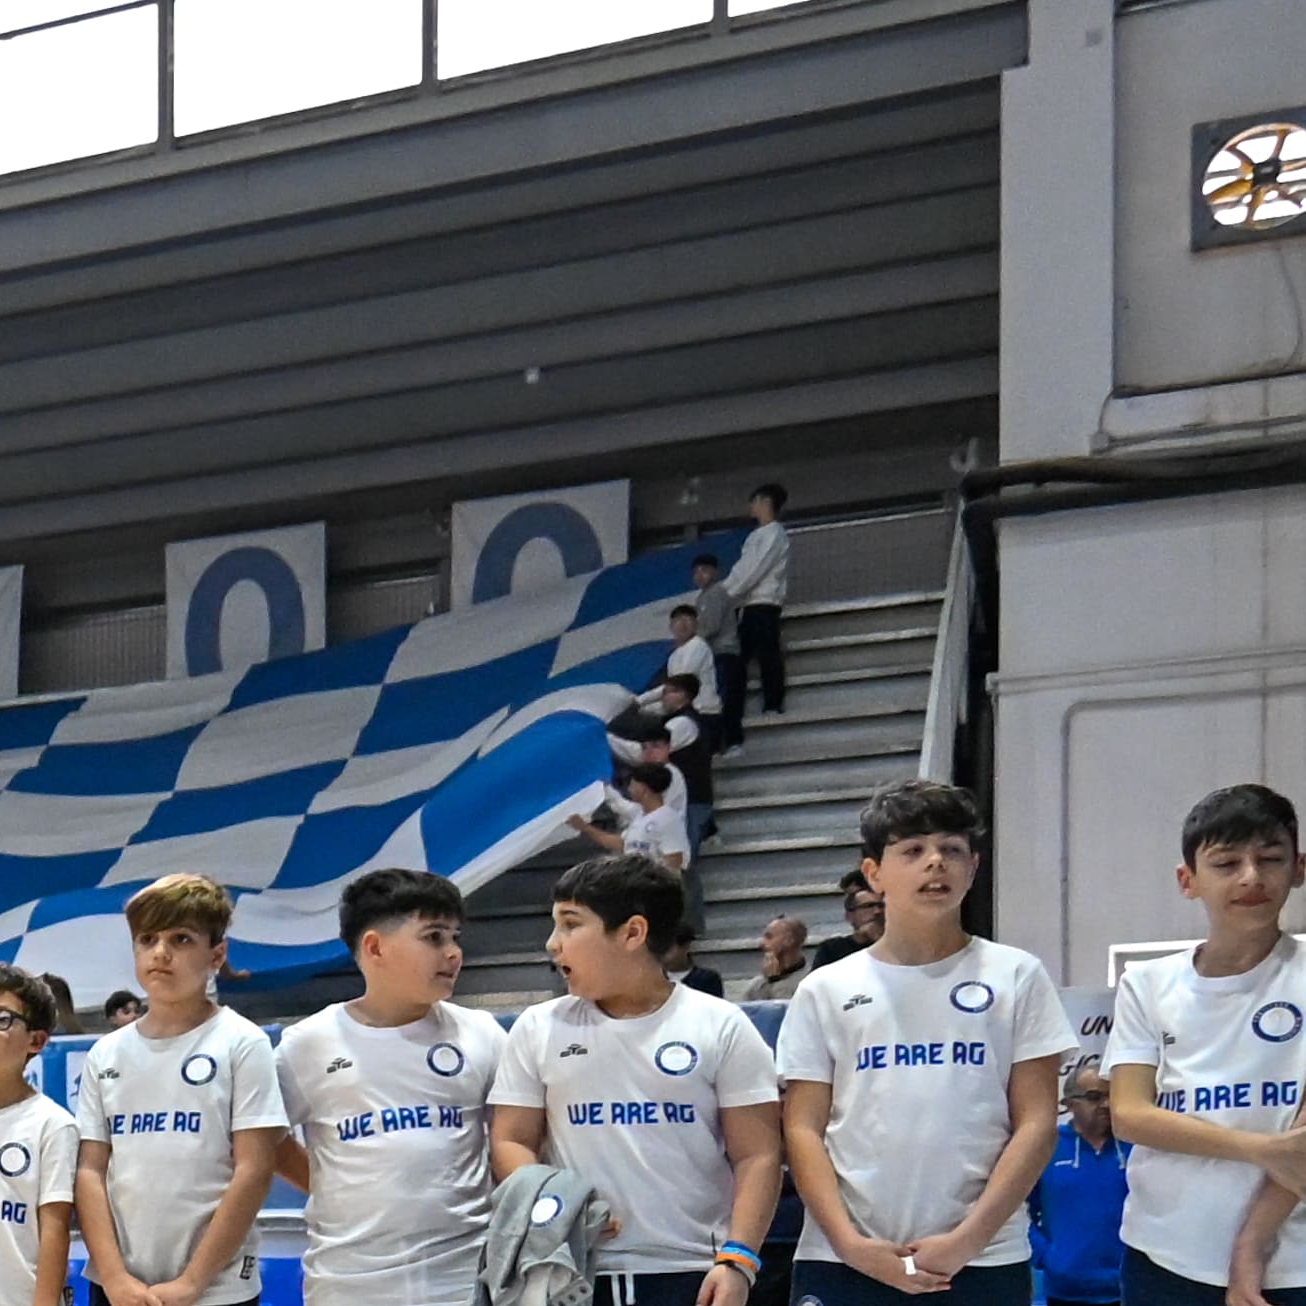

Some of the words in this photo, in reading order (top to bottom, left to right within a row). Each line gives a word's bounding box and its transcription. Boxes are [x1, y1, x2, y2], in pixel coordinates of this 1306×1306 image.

[894, 1043, 944, 1066] ARE
[952, 1041, 985, 1065] AG
[1195, 1083, 1251, 1111] ARE
[1261, 1081, 1298, 1107] AG
[130, 1112, 168, 1134] ARE
[173, 1111, 201, 1133] AG
[337, 1112, 375, 1141] WE
[381, 1105, 433, 1133] ARE
[439, 1105, 464, 1128] AG
[567, 1102, 604, 1125] WE
[610, 1102, 659, 1125] ARE
[663, 1102, 695, 1124] AG
[1, 1200, 28, 1224] AG
